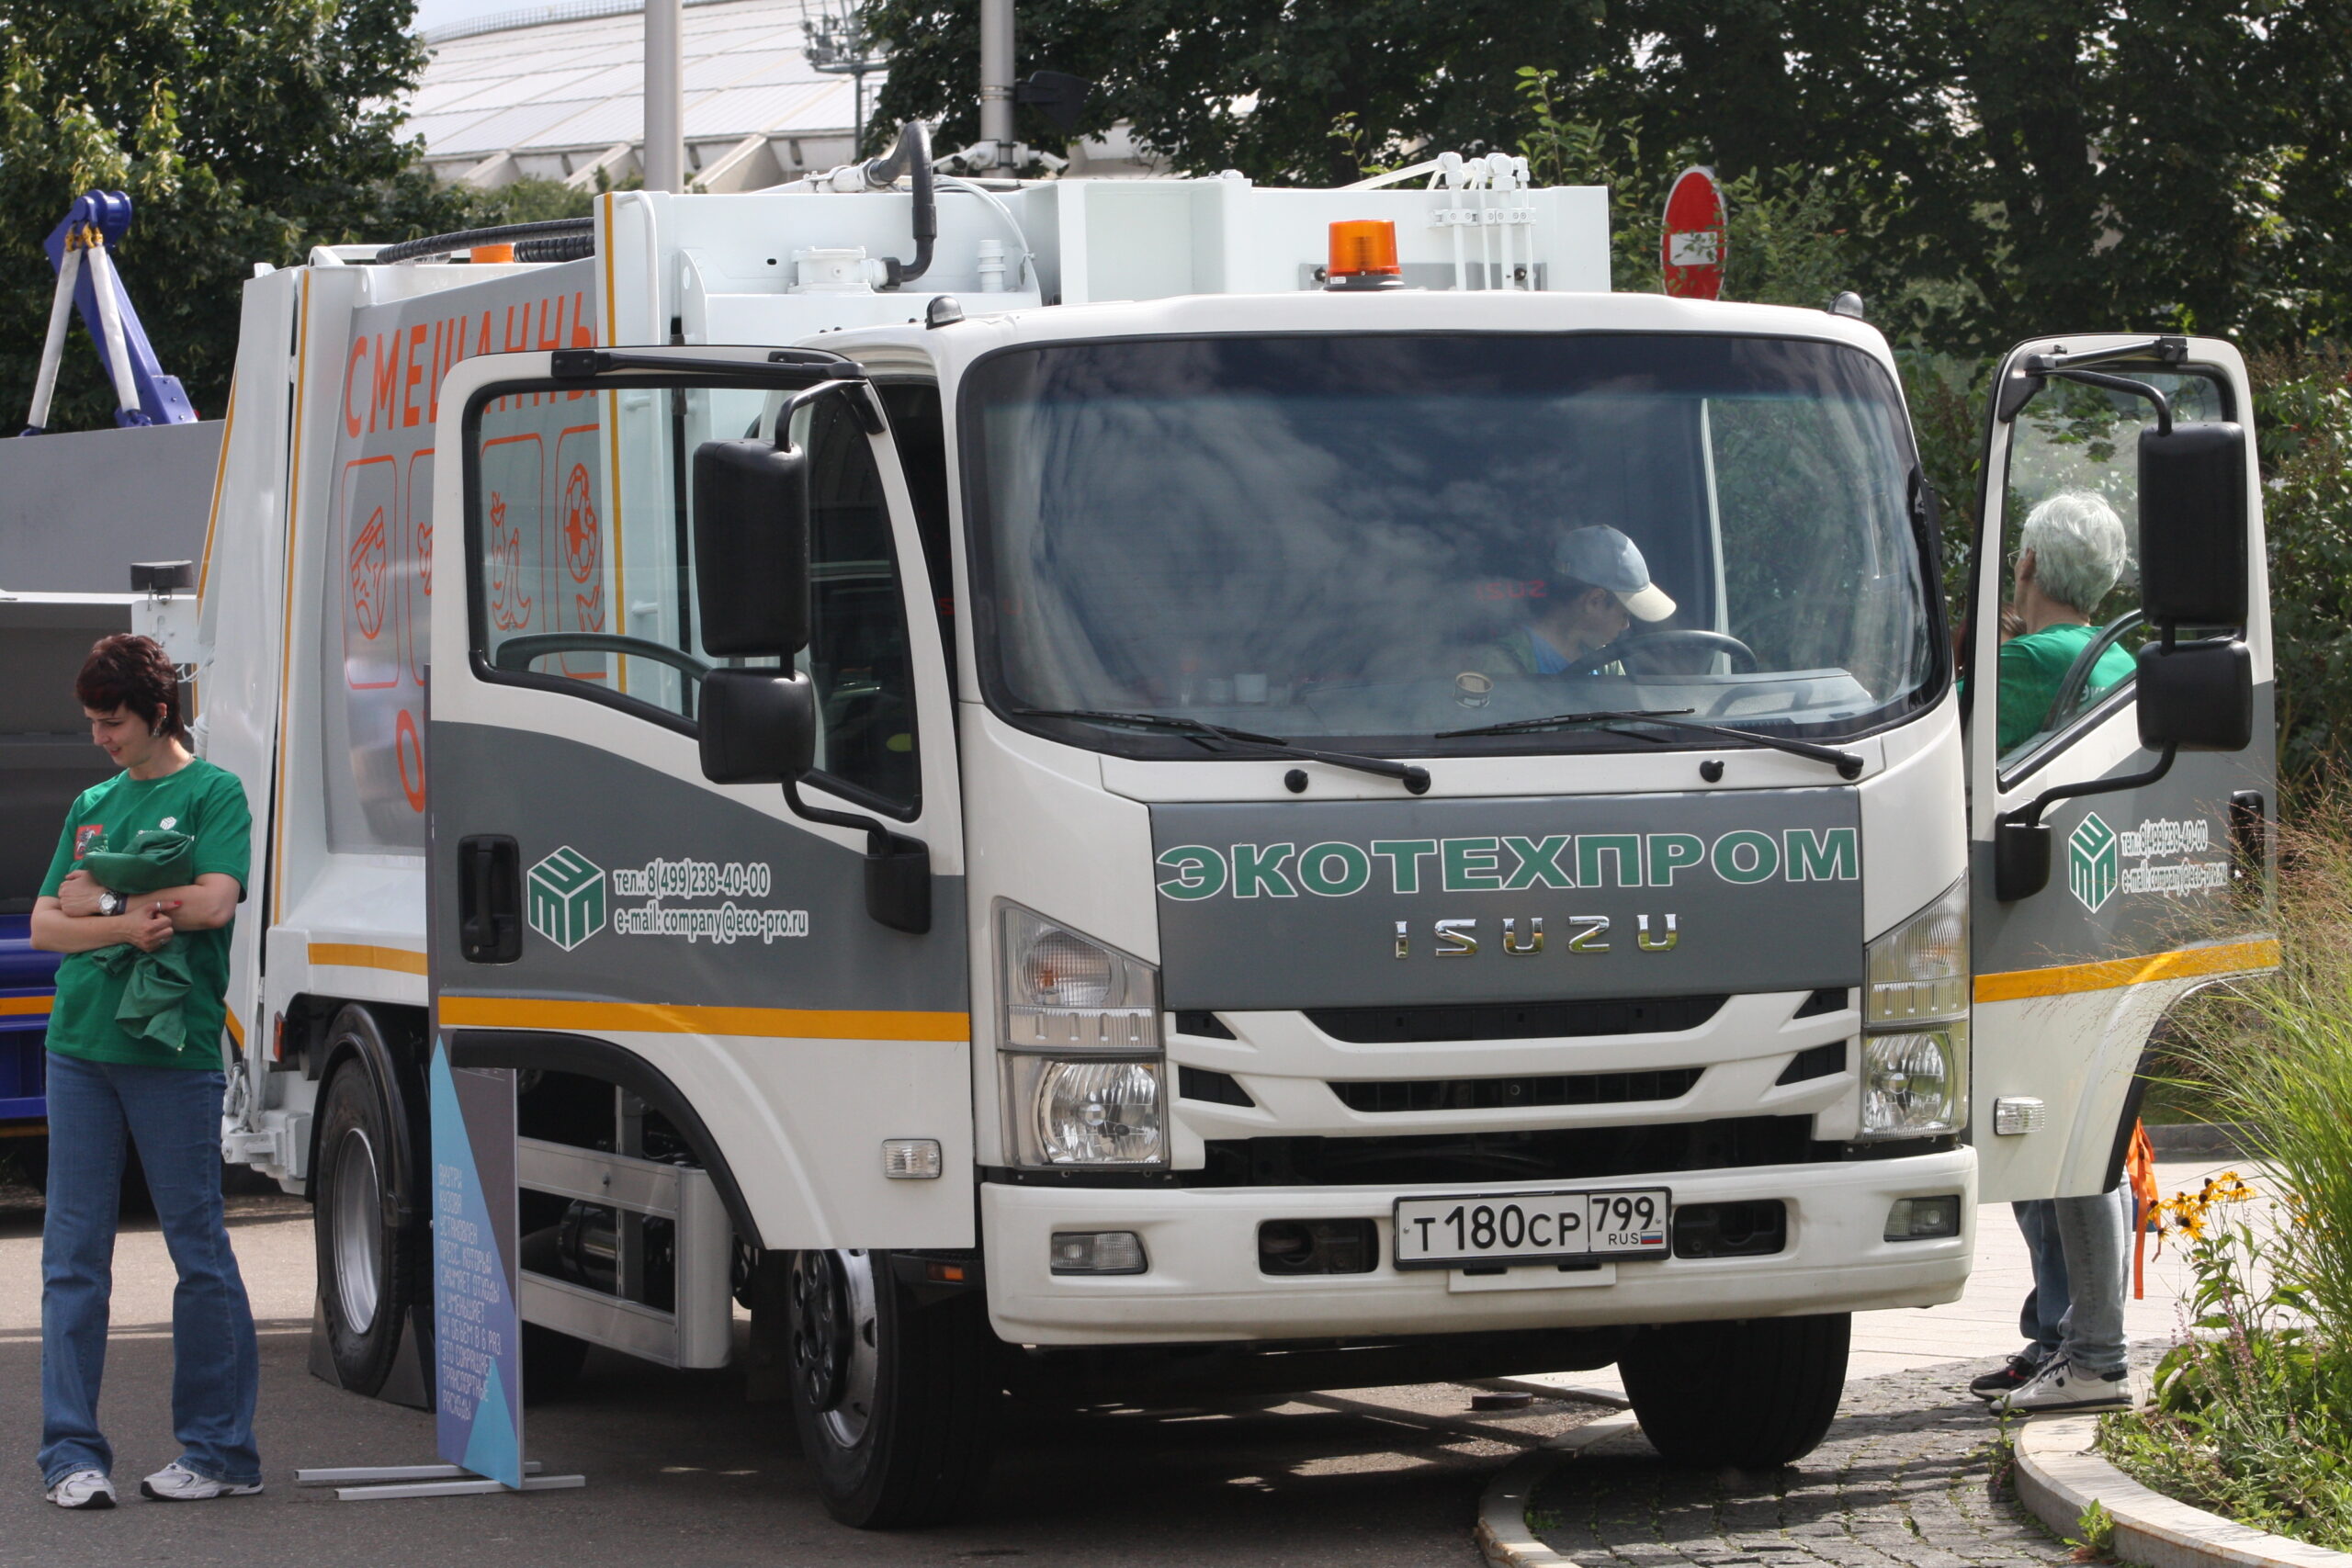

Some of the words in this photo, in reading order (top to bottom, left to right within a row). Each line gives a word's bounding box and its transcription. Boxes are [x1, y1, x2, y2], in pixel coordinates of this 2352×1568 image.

[345, 292, 598, 439] СМЕШАННЫ
[1475, 580, 1549, 601] ISUZ
[1157, 829, 1860, 900] ЭКОТЕХПРОМ
[1394, 913, 1679, 959] ISUZU
[439, 1214, 478, 1246] УСТАНОВЛЕН
[1592, 1196, 1655, 1232] 799
[1608, 1233, 1639, 1245] RUS
[462, 1247, 492, 1275] КОТОРЫЙ
[472, 1274, 500, 1304] ОТХОДЫ
[447, 1292, 485, 1324] УМЕНЬШАЕТ
[441, 1314, 449, 1337] ИХ
[441, 1339, 454, 1364] ЭТО
[442, 1364, 489, 1403] ТРАНСПОРТНЫЕ
